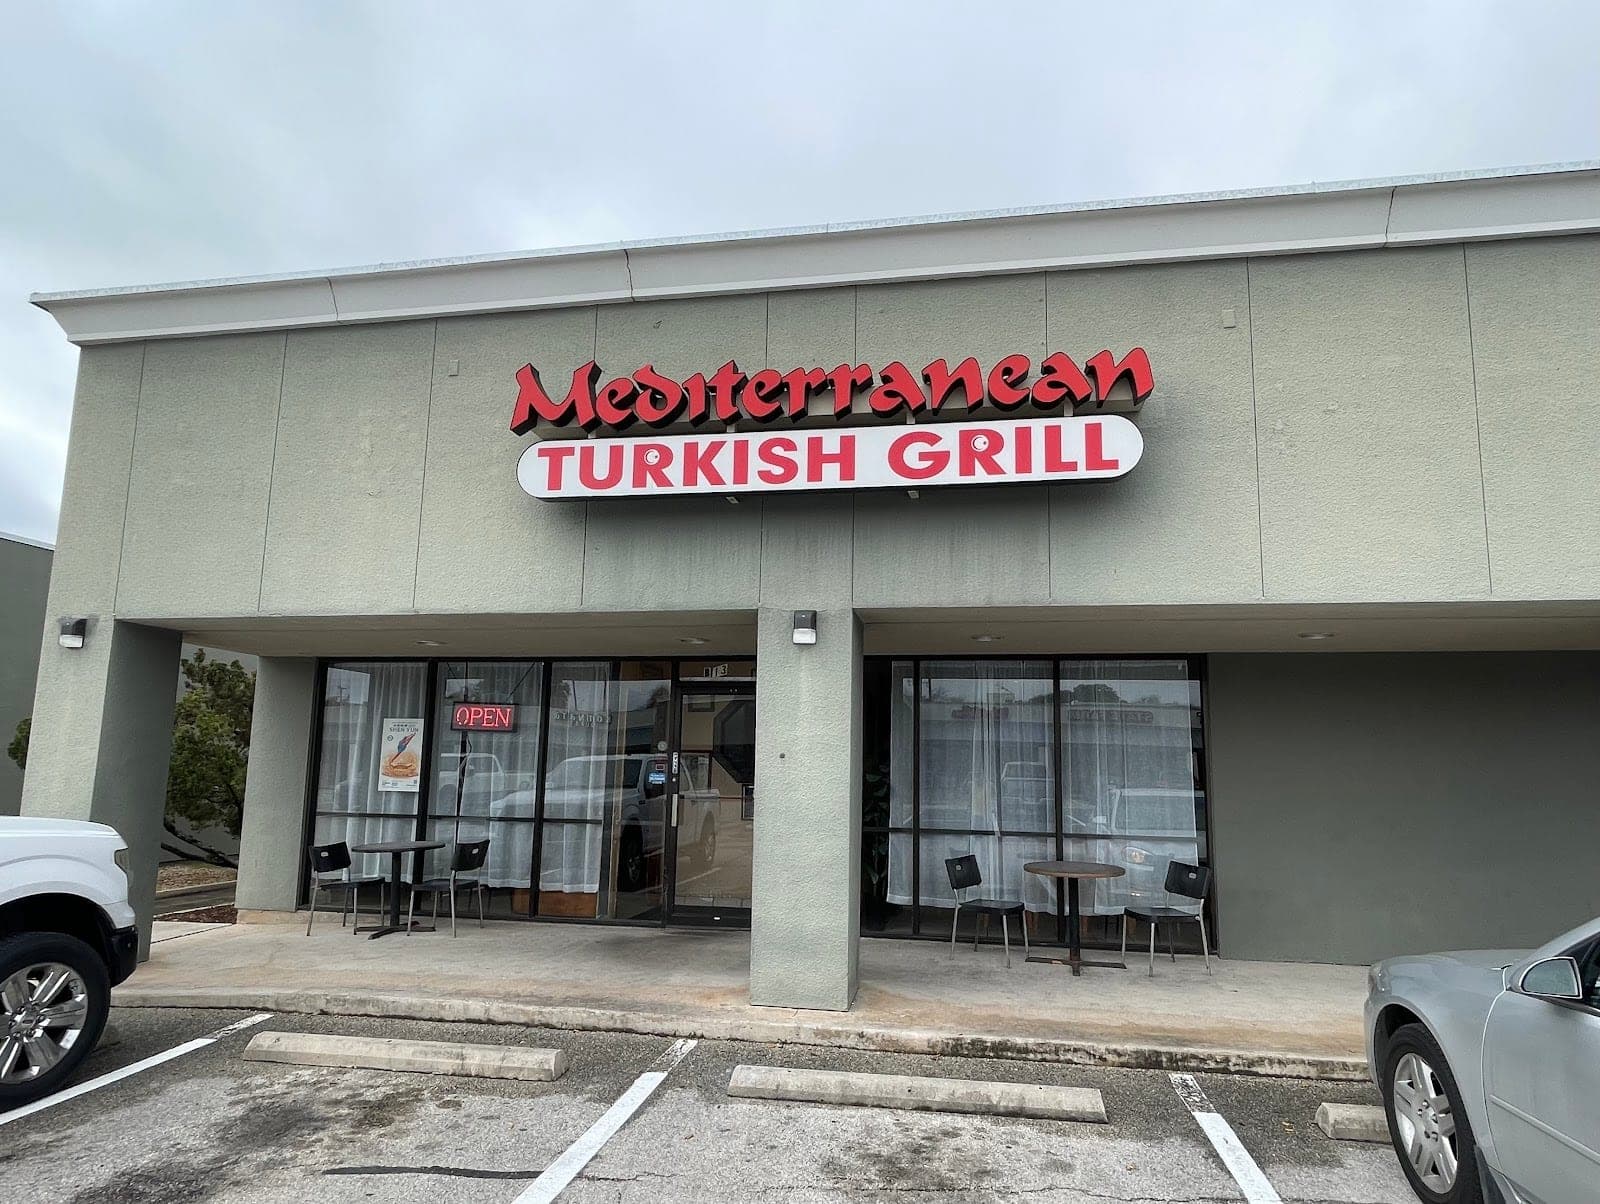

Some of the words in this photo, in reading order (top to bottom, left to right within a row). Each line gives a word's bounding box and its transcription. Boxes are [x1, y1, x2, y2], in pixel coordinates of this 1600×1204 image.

[510, 347, 1154, 433] Mediterranean
[538, 434, 856, 491] TURKISH
[887, 422, 1120, 480] GRILL
[456, 706, 512, 727] OPEN
